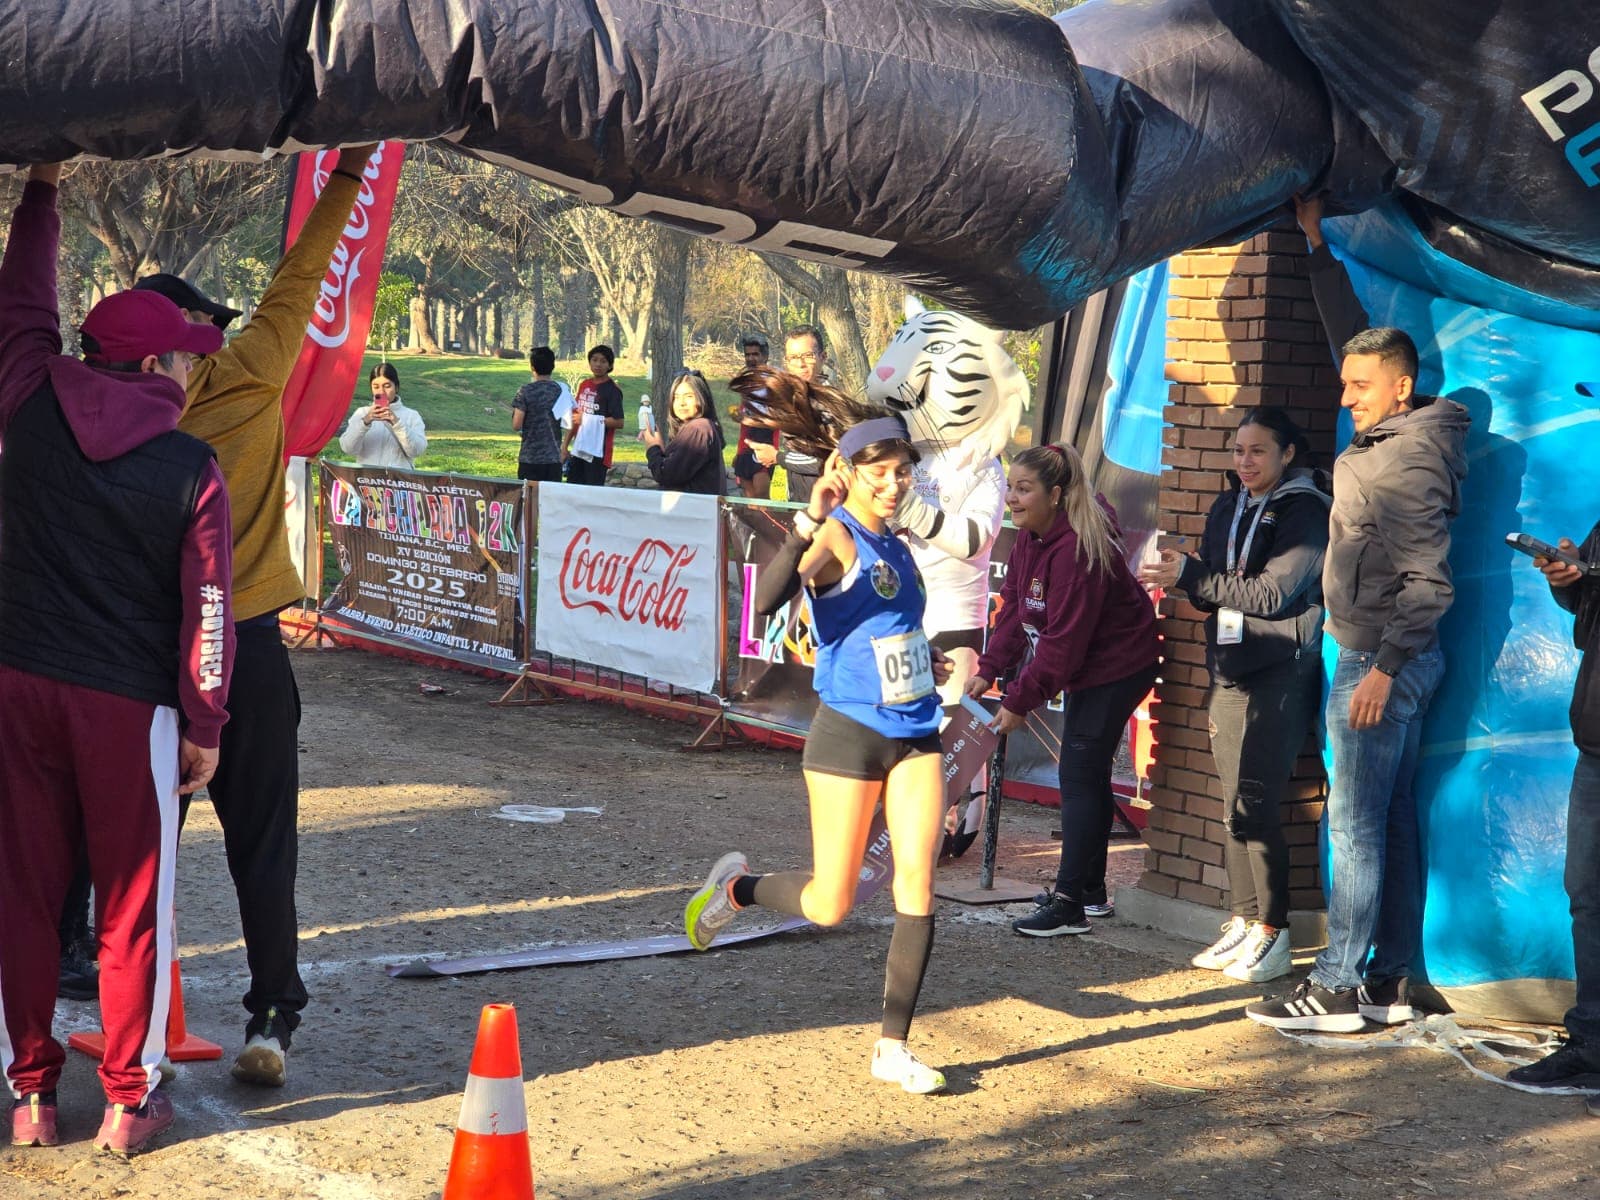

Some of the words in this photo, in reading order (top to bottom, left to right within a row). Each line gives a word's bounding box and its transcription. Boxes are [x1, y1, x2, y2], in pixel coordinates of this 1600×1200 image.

[357, 477, 386, 485] GRAN
[387, 479, 429, 492] CARRERA
[432, 485, 484, 497] ATLÉTICA
[331, 480, 361, 527] LA
[359, 485, 471, 545] ENCHILADA
[475, 499, 519, 553] 12K
[366, 552, 418, 570] DOMINGO
[421, 561, 431, 573] 23
[432, 565, 487, 583] FEBRERO
[397, 546, 411, 557] XV
[414, 548, 451, 564] EDICIÓN
[386, 568, 466, 598] 2025
[396, 605, 426, 623] 7:00
[430, 615, 453, 629] A.M.
[423, 594, 472, 611] DEPORTIVA
[394, 621, 433, 639] ATLÉTICO
[432, 631, 471, 650] INFANTIL
[471, 640, 480, 651] Y
[479, 642, 517, 661] JUVENIL
[885, 643, 929, 684] 0513
